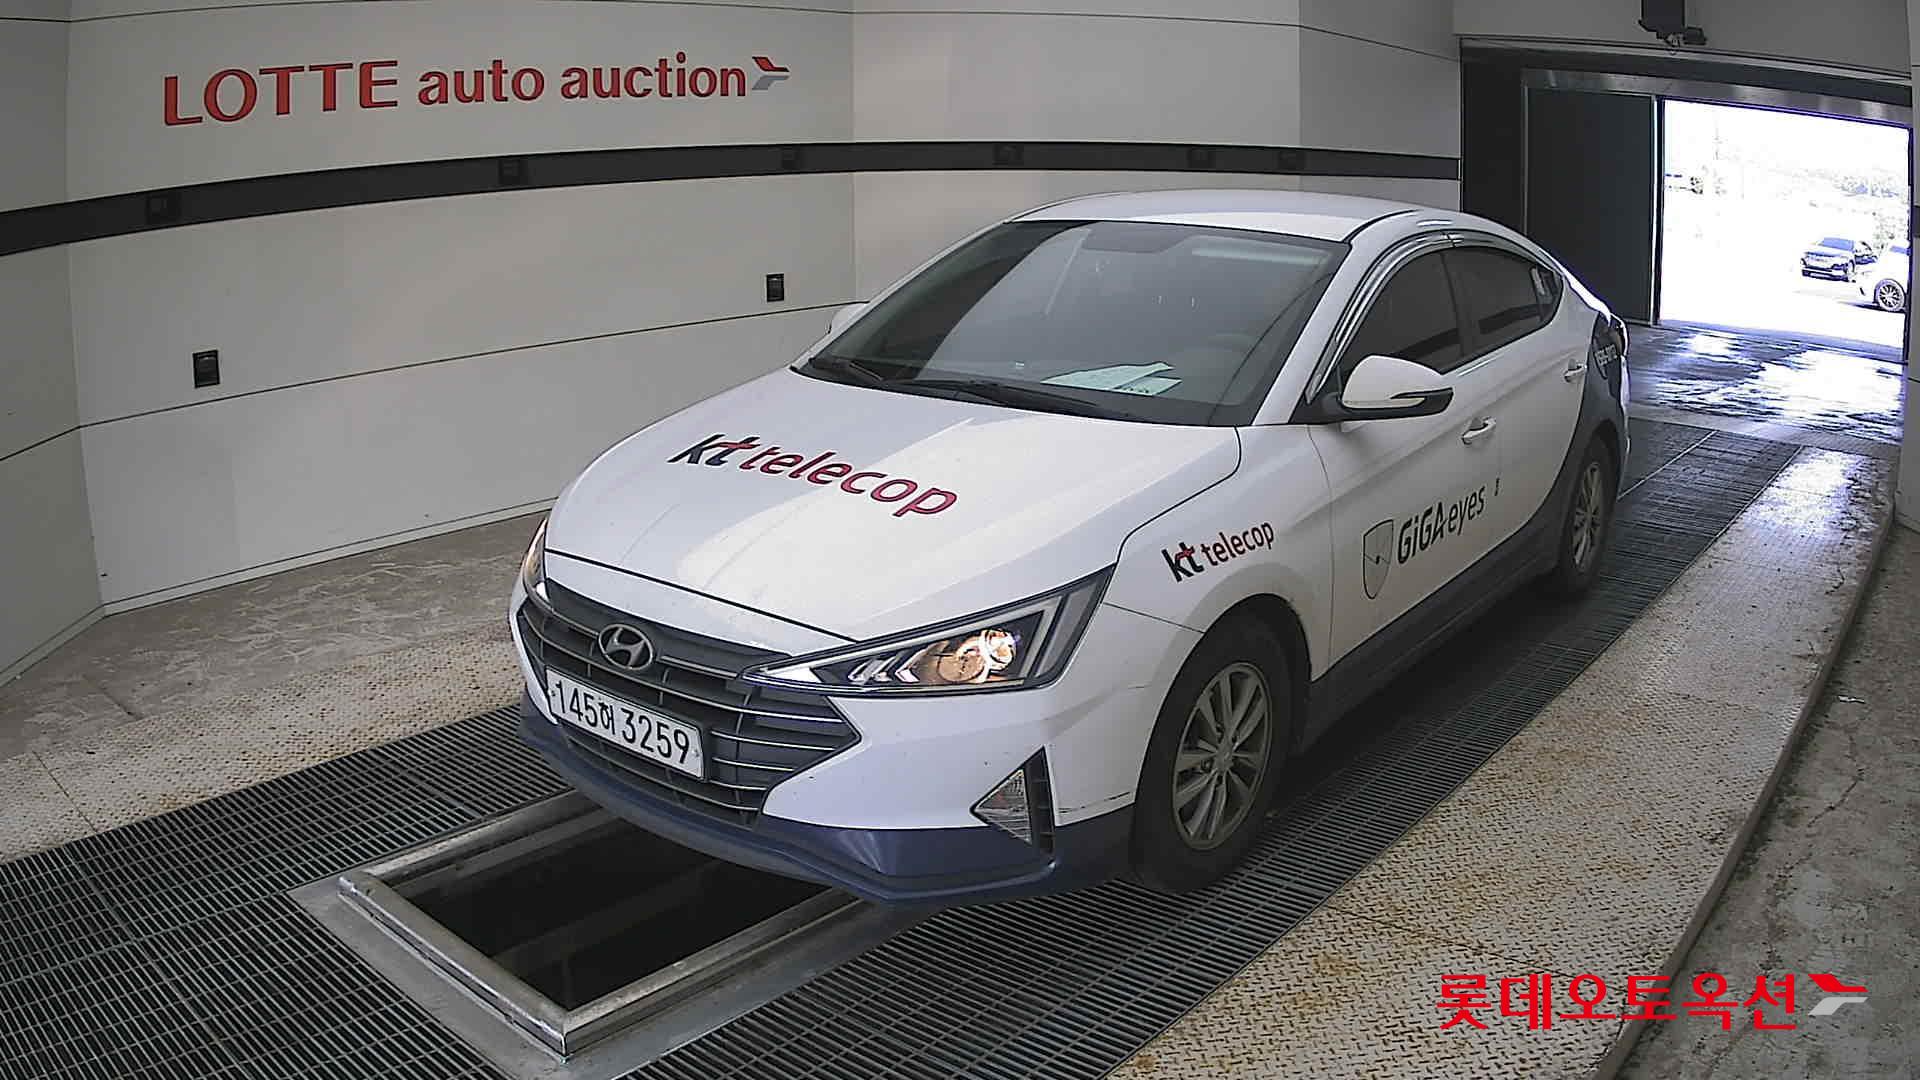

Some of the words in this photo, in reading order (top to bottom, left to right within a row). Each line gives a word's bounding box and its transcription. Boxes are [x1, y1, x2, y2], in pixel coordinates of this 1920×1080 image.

[163, 60, 399, 127] LOTTE
[417, 58, 545, 106] auto
[560, 51, 746, 99] auction
[667, 433, 760, 466] kt
[739, 446, 957, 517] telecop
[1161, 542, 1204, 582] kt
[1200, 522, 1274, 566] telecop
